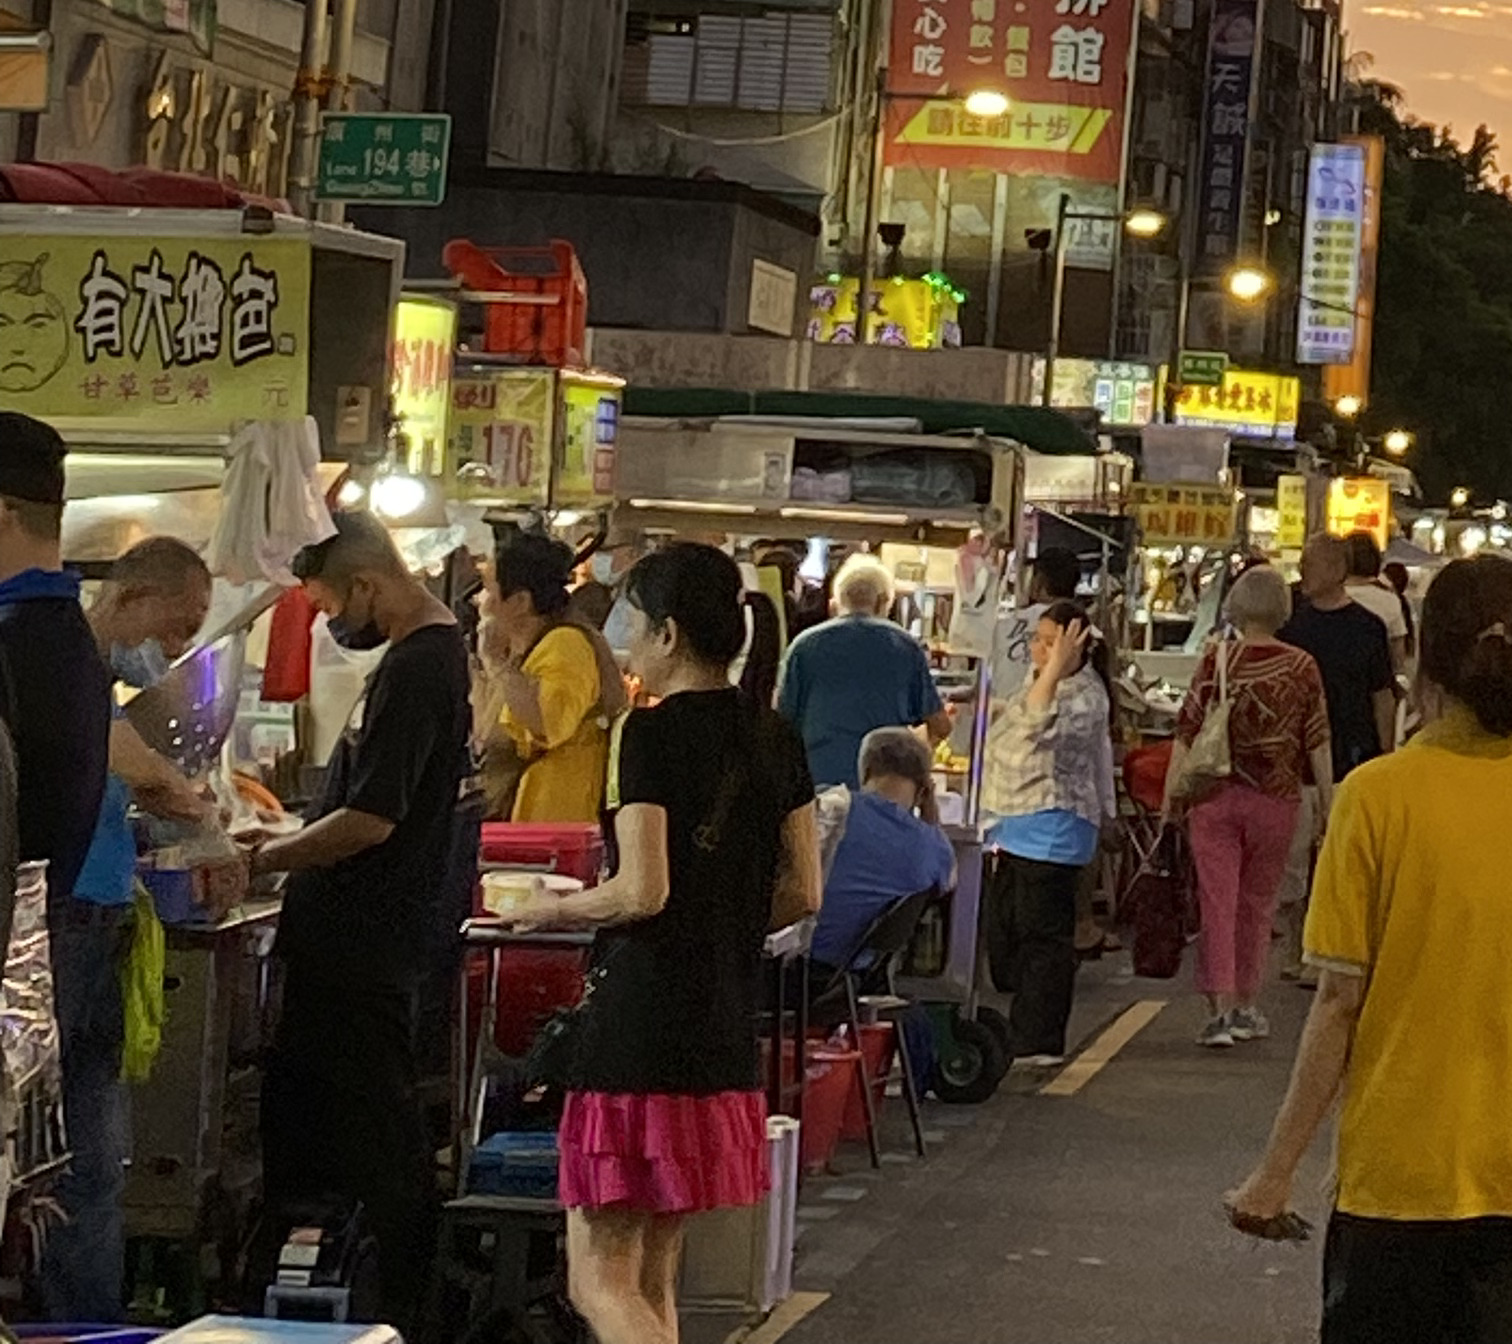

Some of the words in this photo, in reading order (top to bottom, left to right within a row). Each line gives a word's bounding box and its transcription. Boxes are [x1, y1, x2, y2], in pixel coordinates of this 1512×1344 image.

[364, 148, 399, 176] 194
[405, 149, 431, 179] 巷
[80, 371, 212, 405] 甘草芭樂
